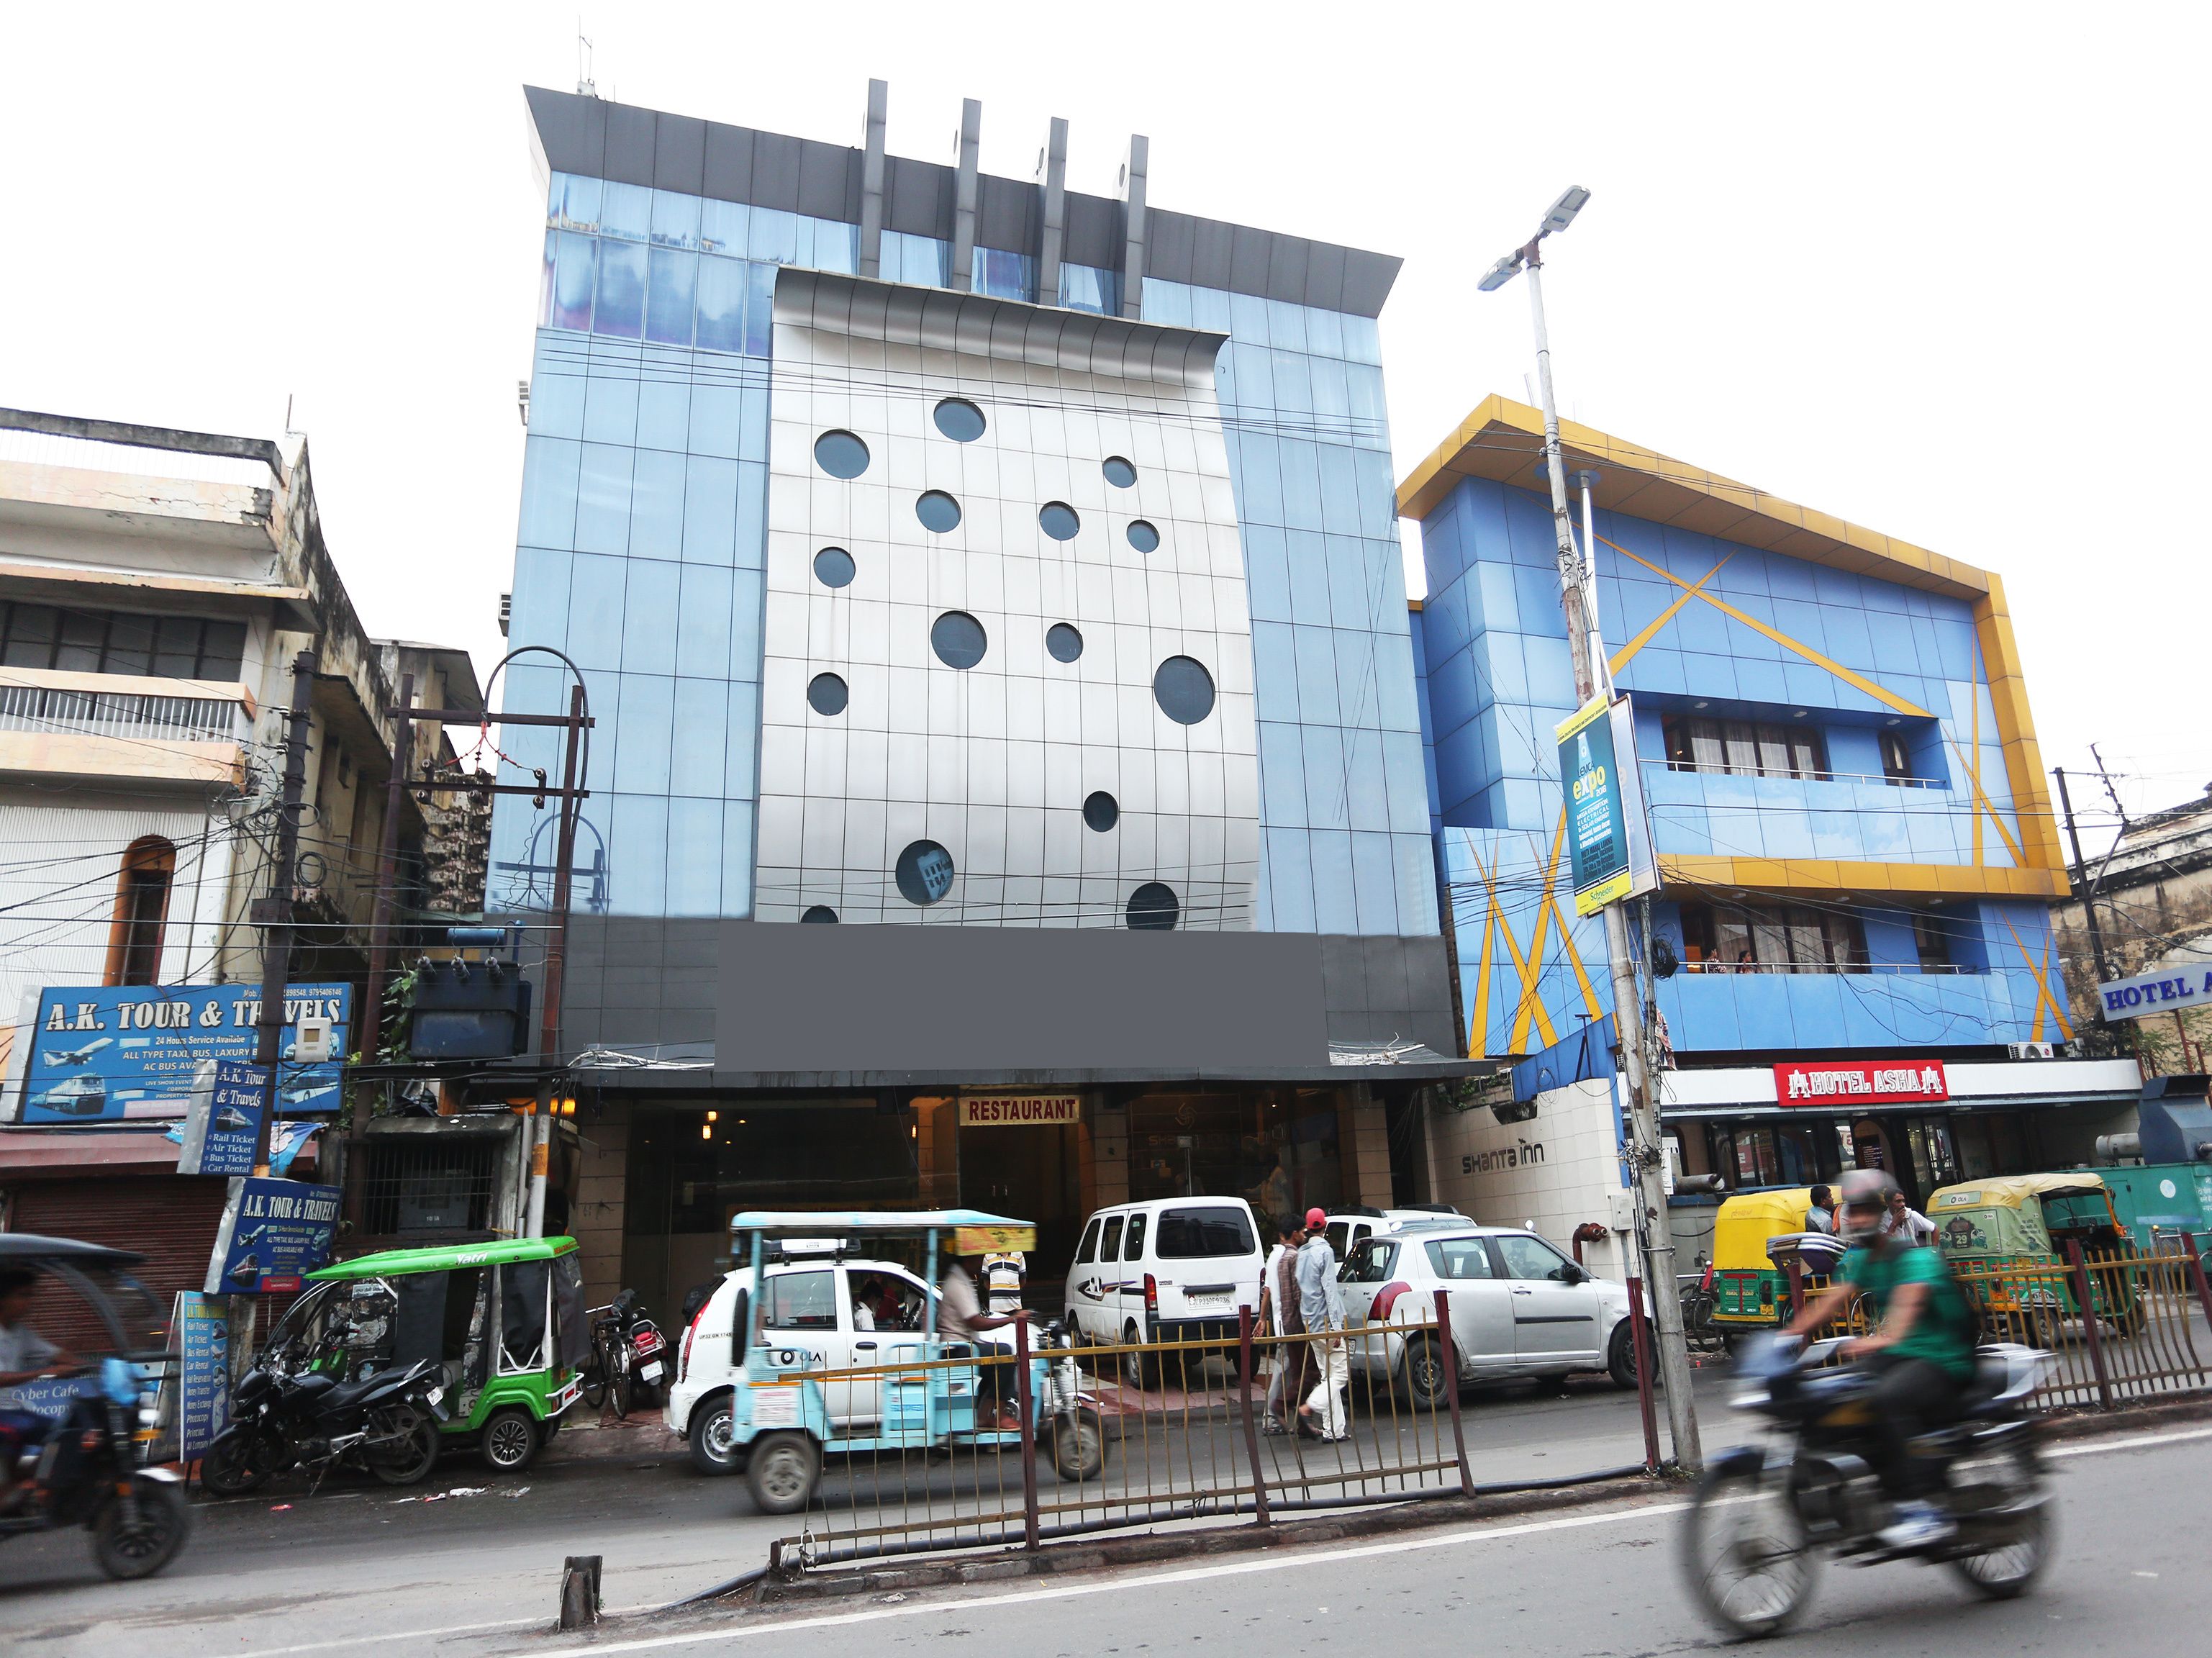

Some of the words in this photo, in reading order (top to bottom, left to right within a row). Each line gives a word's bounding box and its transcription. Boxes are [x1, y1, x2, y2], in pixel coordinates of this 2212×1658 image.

[1572, 765, 1605, 800] expo
[1590, 886, 1613, 901] Schneider
[2104, 977, 2194, 1010] HOTEL
[46, 1003, 106, 1031] A.K.
[117, 1001, 191, 1030] TOUR
[199, 1000, 223, 1028] &
[155, 1036, 164, 1045] 24
[166, 1036, 186, 1045] Hours
[189, 1035, 214, 1044] Service
[142, 1051, 164, 1059] TYPE
[158, 1062, 176, 1071] BUS
[245, 1070, 266, 1086] Tour
[1808, 1071, 1872, 1095] HOTEL
[1874, 1069, 1922, 1093] ASHA
[217, 1089, 227, 1104] &
[230, 1090, 260, 1107] Travels
[969, 1099, 1076, 1121] RESTAURANT
[213, 1133, 230, 1142] Rail
[232, 1134, 255, 1144] Ticket
[228, 1145, 251, 1154] Ticket
[209, 1154, 225, 1162] Bus
[227, 1154, 251, 1164] Ticket
[208, 1164, 222, 1172] Car
[225, 1164, 249, 1173] Rental
[243, 1195, 265, 1218] A.K.
[268, 1196, 293, 1218] TOUR
[294, 1198, 302, 1219] &
[303, 1199, 337, 1221] TRAVELS
[1955, 1235, 1967, 1244] 29
[456, 1251, 489, 1266] Yatri
[12, 1388, 48, 1401] Cyber
[52, 1384, 79, 1397] Cafe
